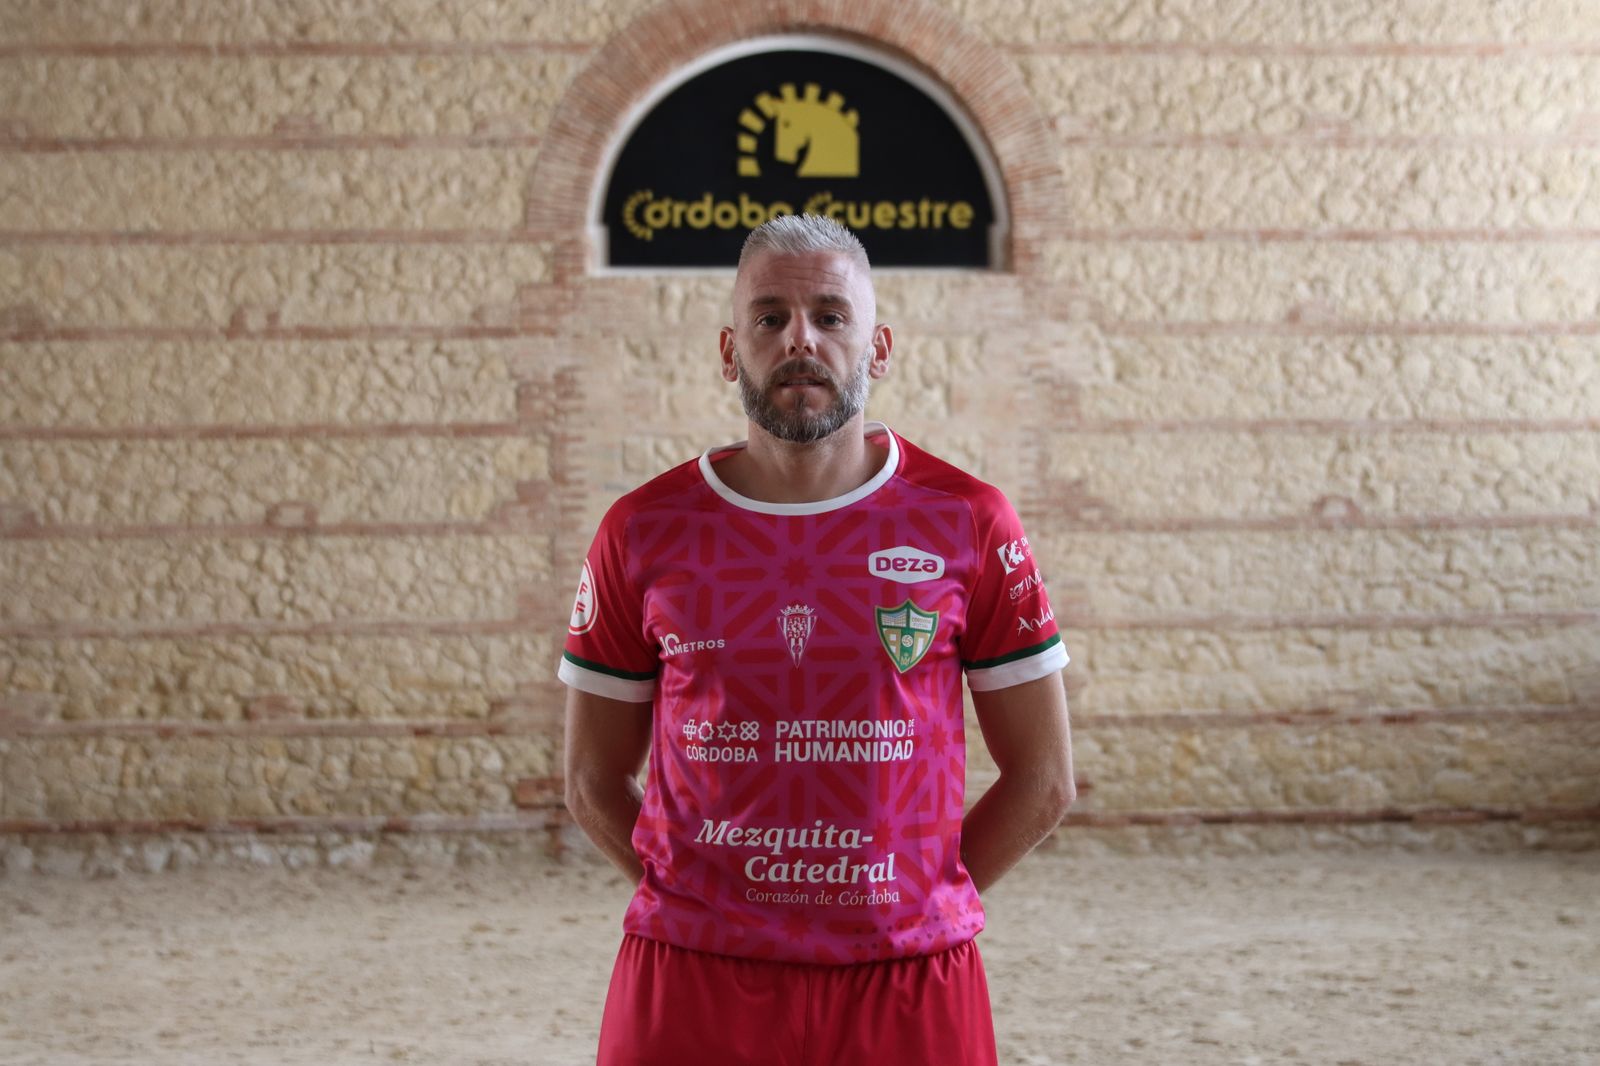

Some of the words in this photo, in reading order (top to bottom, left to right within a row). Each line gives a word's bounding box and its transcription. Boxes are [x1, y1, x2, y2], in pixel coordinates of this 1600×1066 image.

[776, 719, 906, 739] PATRIMONIO
[686, 743, 758, 762] CÓRDOBA
[774, 739, 914, 762] HUMANIDAD
[694, 819, 873, 855] Mezquita-
[744, 853, 896, 884] Catedral
[746, 888, 809, 904] Corazón
[815, 890, 832, 905] de
[839, 888, 900, 905] Córdoba
